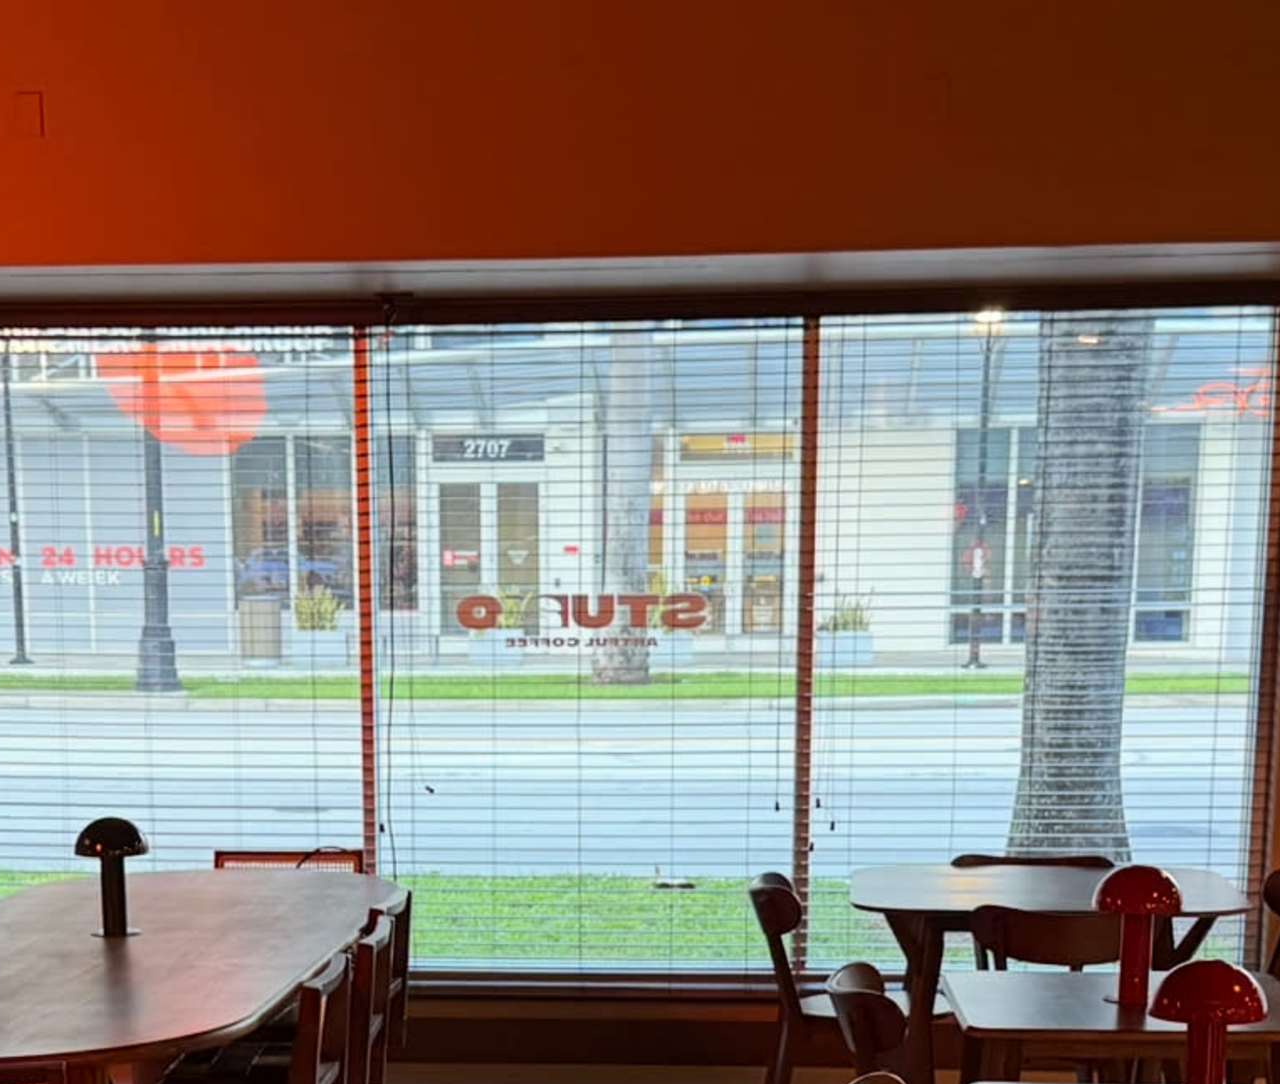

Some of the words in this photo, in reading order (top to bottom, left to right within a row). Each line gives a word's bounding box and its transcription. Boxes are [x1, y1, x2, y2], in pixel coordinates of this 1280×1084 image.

[463, 440, 511, 458] 2707
[41, 546, 75, 569] 24
[59, 571, 120, 585] WEEK
